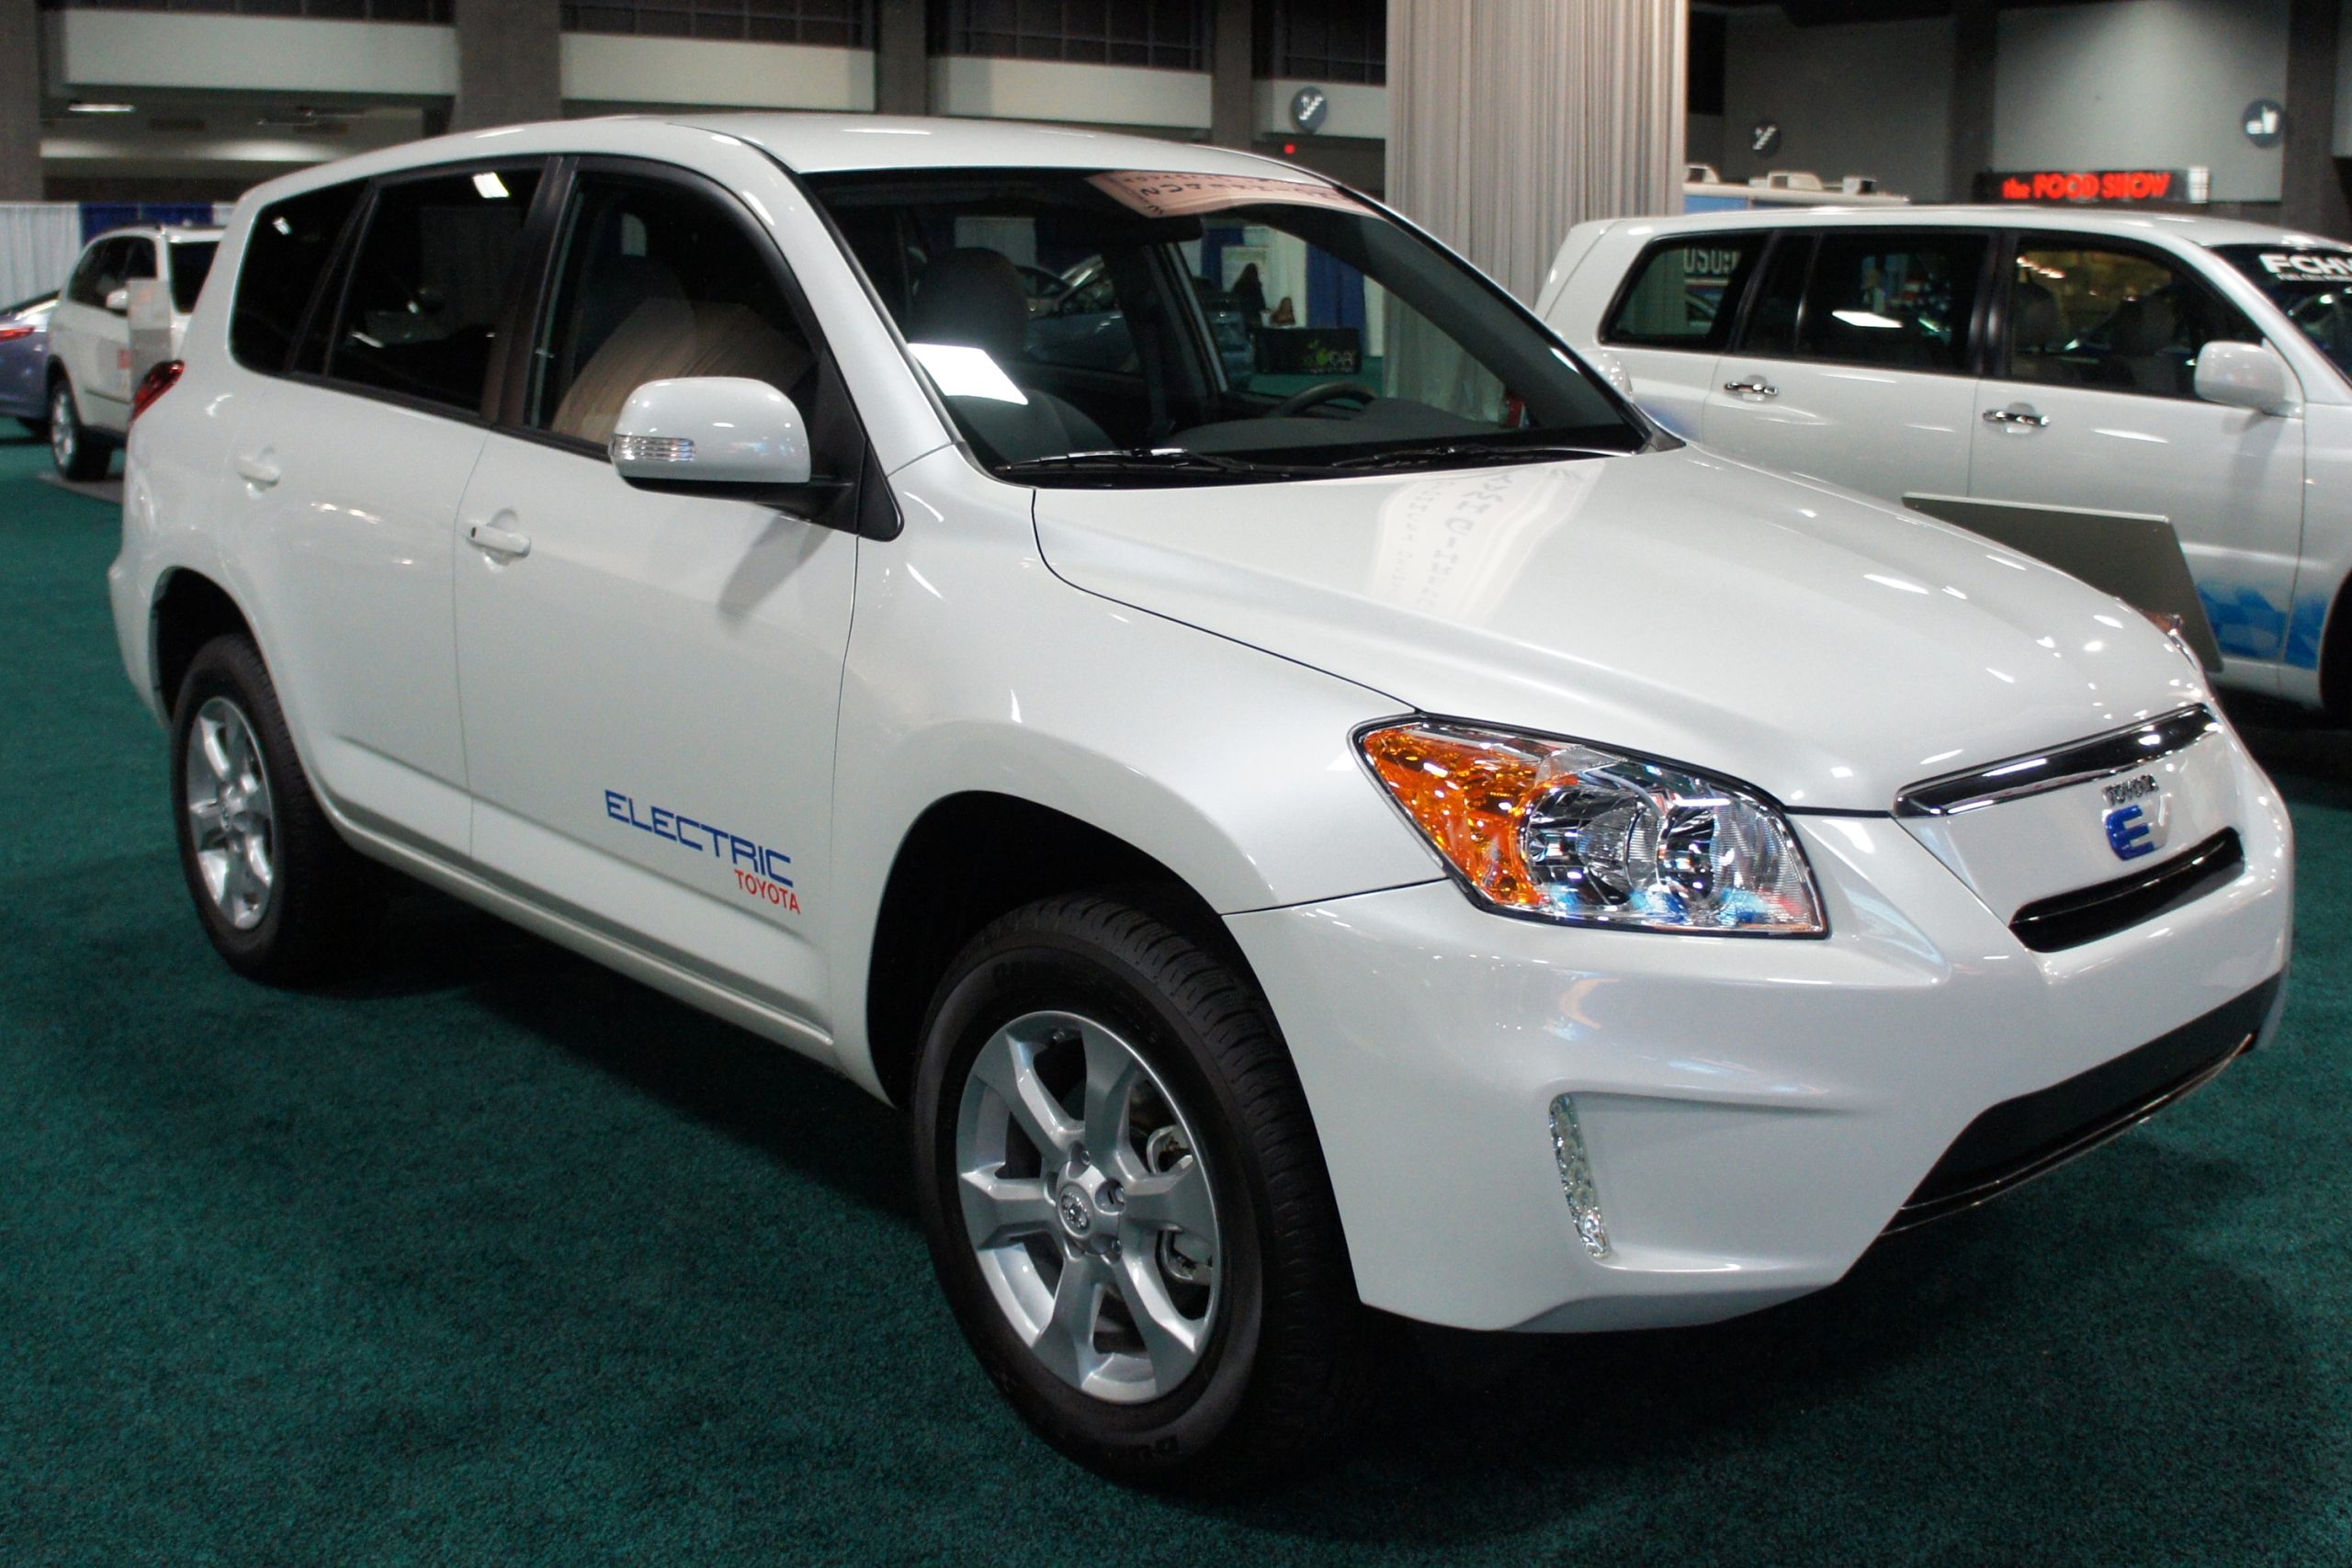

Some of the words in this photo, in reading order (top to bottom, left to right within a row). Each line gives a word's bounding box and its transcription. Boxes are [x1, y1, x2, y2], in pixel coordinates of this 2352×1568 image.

[2033, 172, 2100, 199] FOOD
[2101, 172, 2172, 199] SHOW
[605, 789, 794, 888] ELECTRIC
[734, 867, 801, 915] TOYOTA
